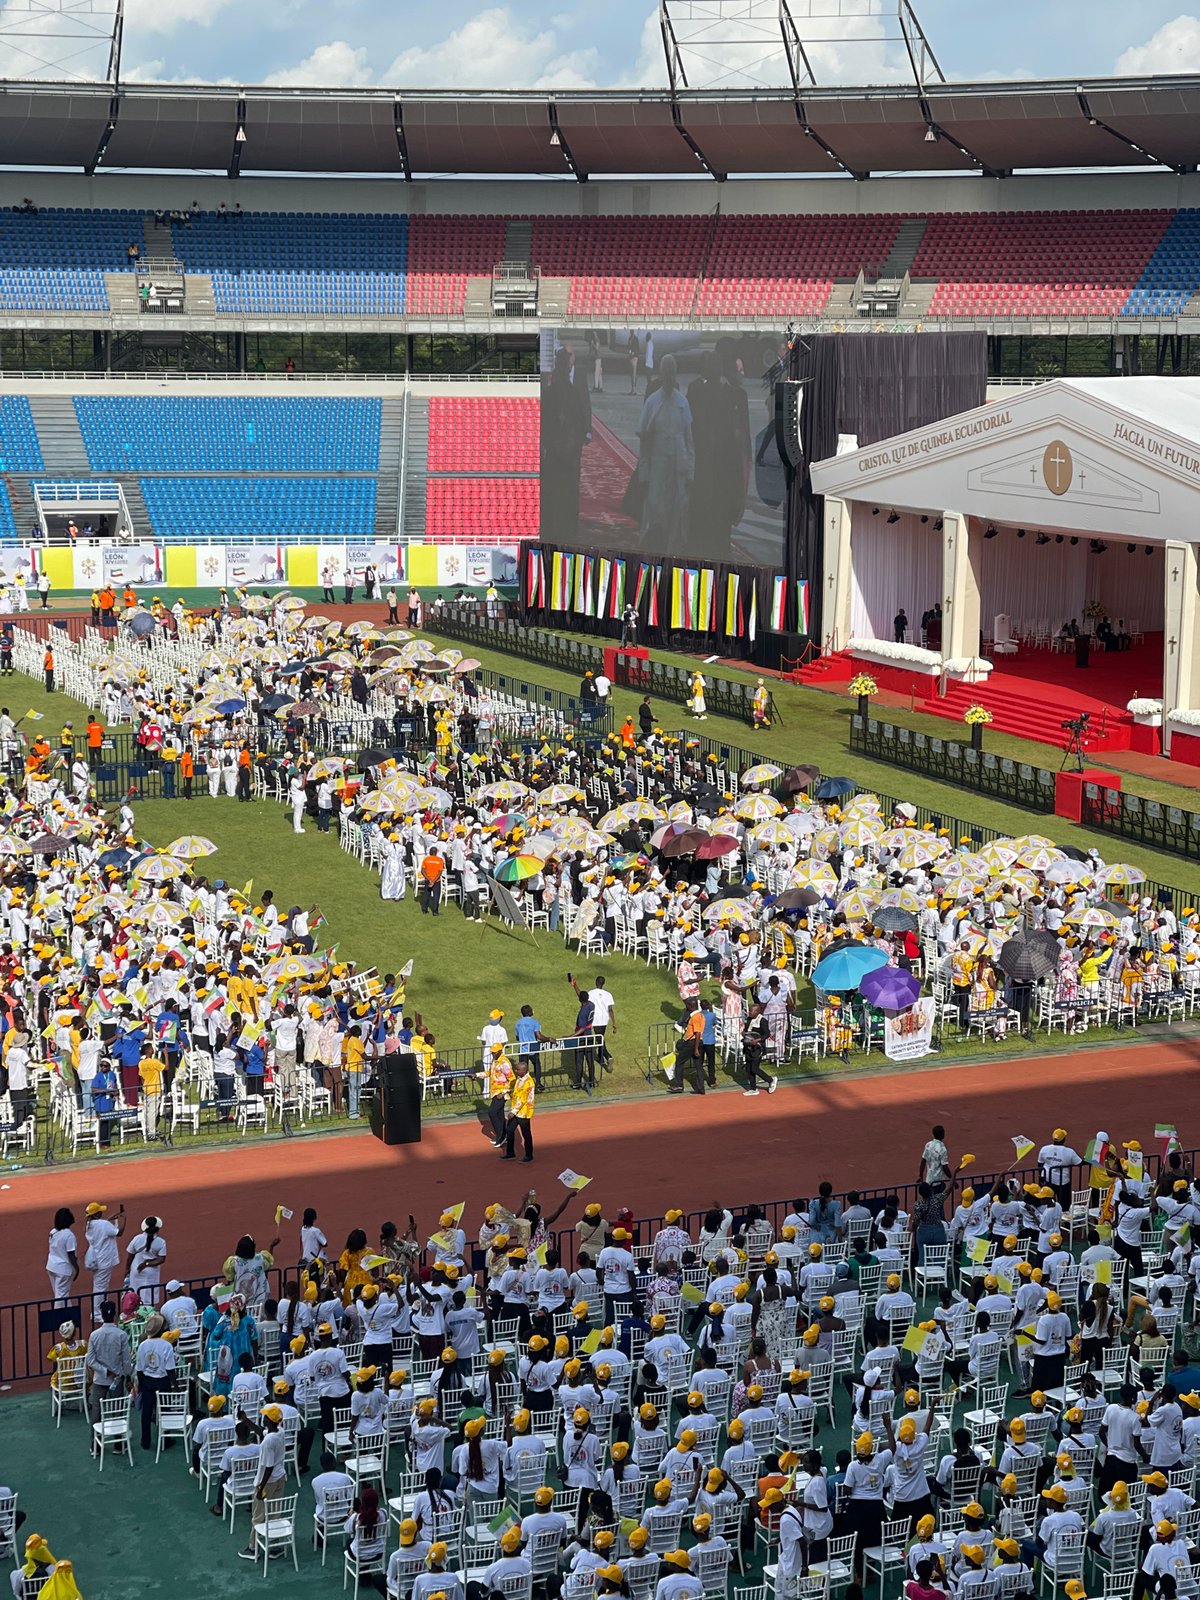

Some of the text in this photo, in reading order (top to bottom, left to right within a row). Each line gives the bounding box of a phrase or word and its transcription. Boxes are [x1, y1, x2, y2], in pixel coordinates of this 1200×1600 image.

[859, 411, 1013, 472] CRISTO, LUZ DE GUINEA ECUATORIAL
[1113, 423, 1145, 449] HACIA
[1147, 439, 1164, 456] UN
